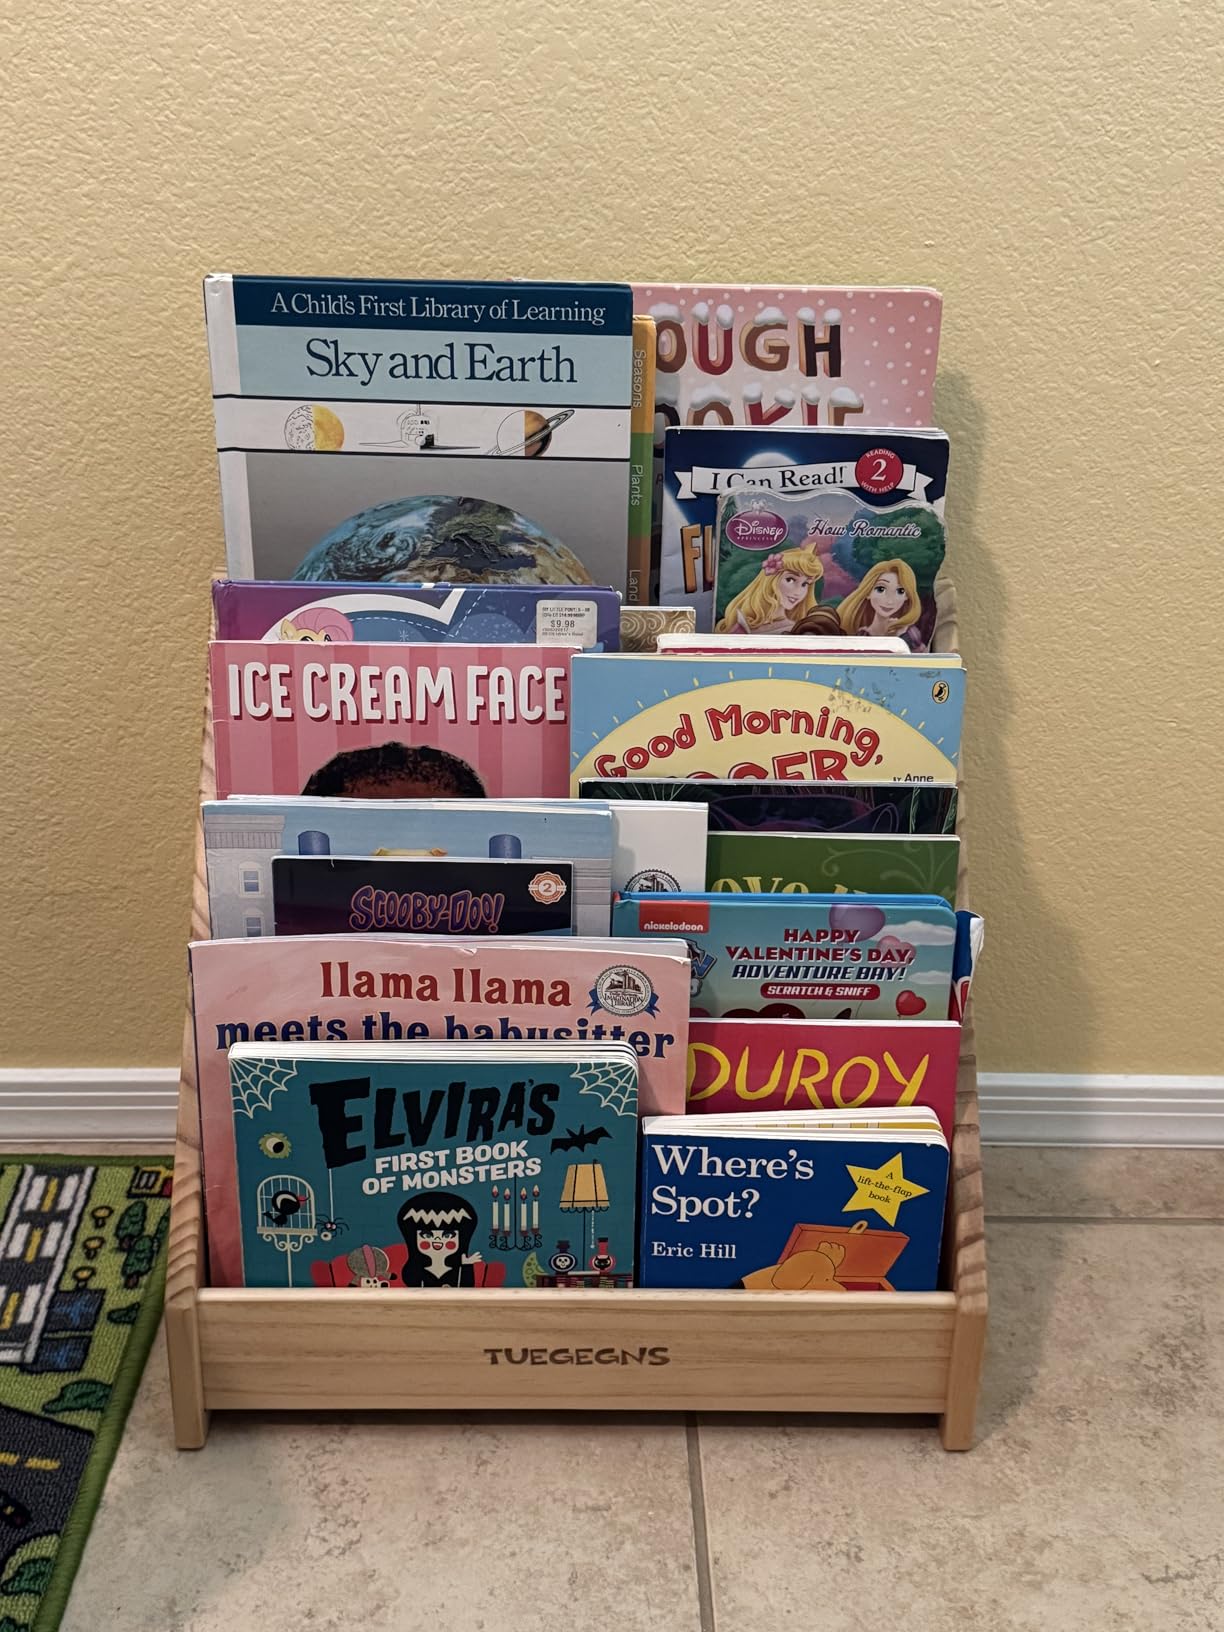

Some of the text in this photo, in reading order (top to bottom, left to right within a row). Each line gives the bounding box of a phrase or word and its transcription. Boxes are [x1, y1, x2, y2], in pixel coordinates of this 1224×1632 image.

[270, 292, 606, 326] A Child's First Library of Learning
[305, 337, 578, 387] Sky and Earth
[632, 349, 647, 409] Seasons
[865, 447, 895, 460] READING
[711, 472, 721, 491] I
[778, 466, 845, 489] Read!
[870, 458, 888, 481] 2
[630, 464, 644, 506] Plants
[861, 480, 895, 493] WITH HELP
[807, 518, 922, 538] How Romantic
[628, 569, 641, 602] Land
[550, 620, 575, 628] $9.98
[228, 662, 568, 724] ICE CREAM FACE
[593, 703, 884, 778] Good Morning,
[904, 772, 934, 783] Anne
[542, 882, 553, 893] 2
[643, 920, 705, 932] nickelodeon
[783, 928, 861, 945] HAPPY
[725, 946, 863, 963] VALENTINE'S
[867, 948, 916, 966] DAY,
[320, 961, 441, 1001] llama
[452, 967, 573, 1007] llama
[731, 964, 908, 982] ADVENTURE BAY!
[766, 985, 872, 997] SCRATCH & SNIFF
[215, 1014, 349, 1050] meets
[361, 1010, 430, 1040] the
[687, 1042, 931, 1109] DUROY
[308, 1075, 561, 1170] ELVIRA'S
[375, 1139, 529, 1175] FIRST BOOK
[651, 1143, 815, 1181] Where's
[361, 1156, 543, 1196] OF MONSTERS
[857, 1175, 913, 1198] lift-the-flap
[885, 1171, 894, 1180] A
[651, 1185, 761, 1223] Spot?
[868, 1190, 892, 1204] book
[651, 1241, 737, 1260] Eric Hill
[483, 1346, 671, 1367] TUEGEGNS
